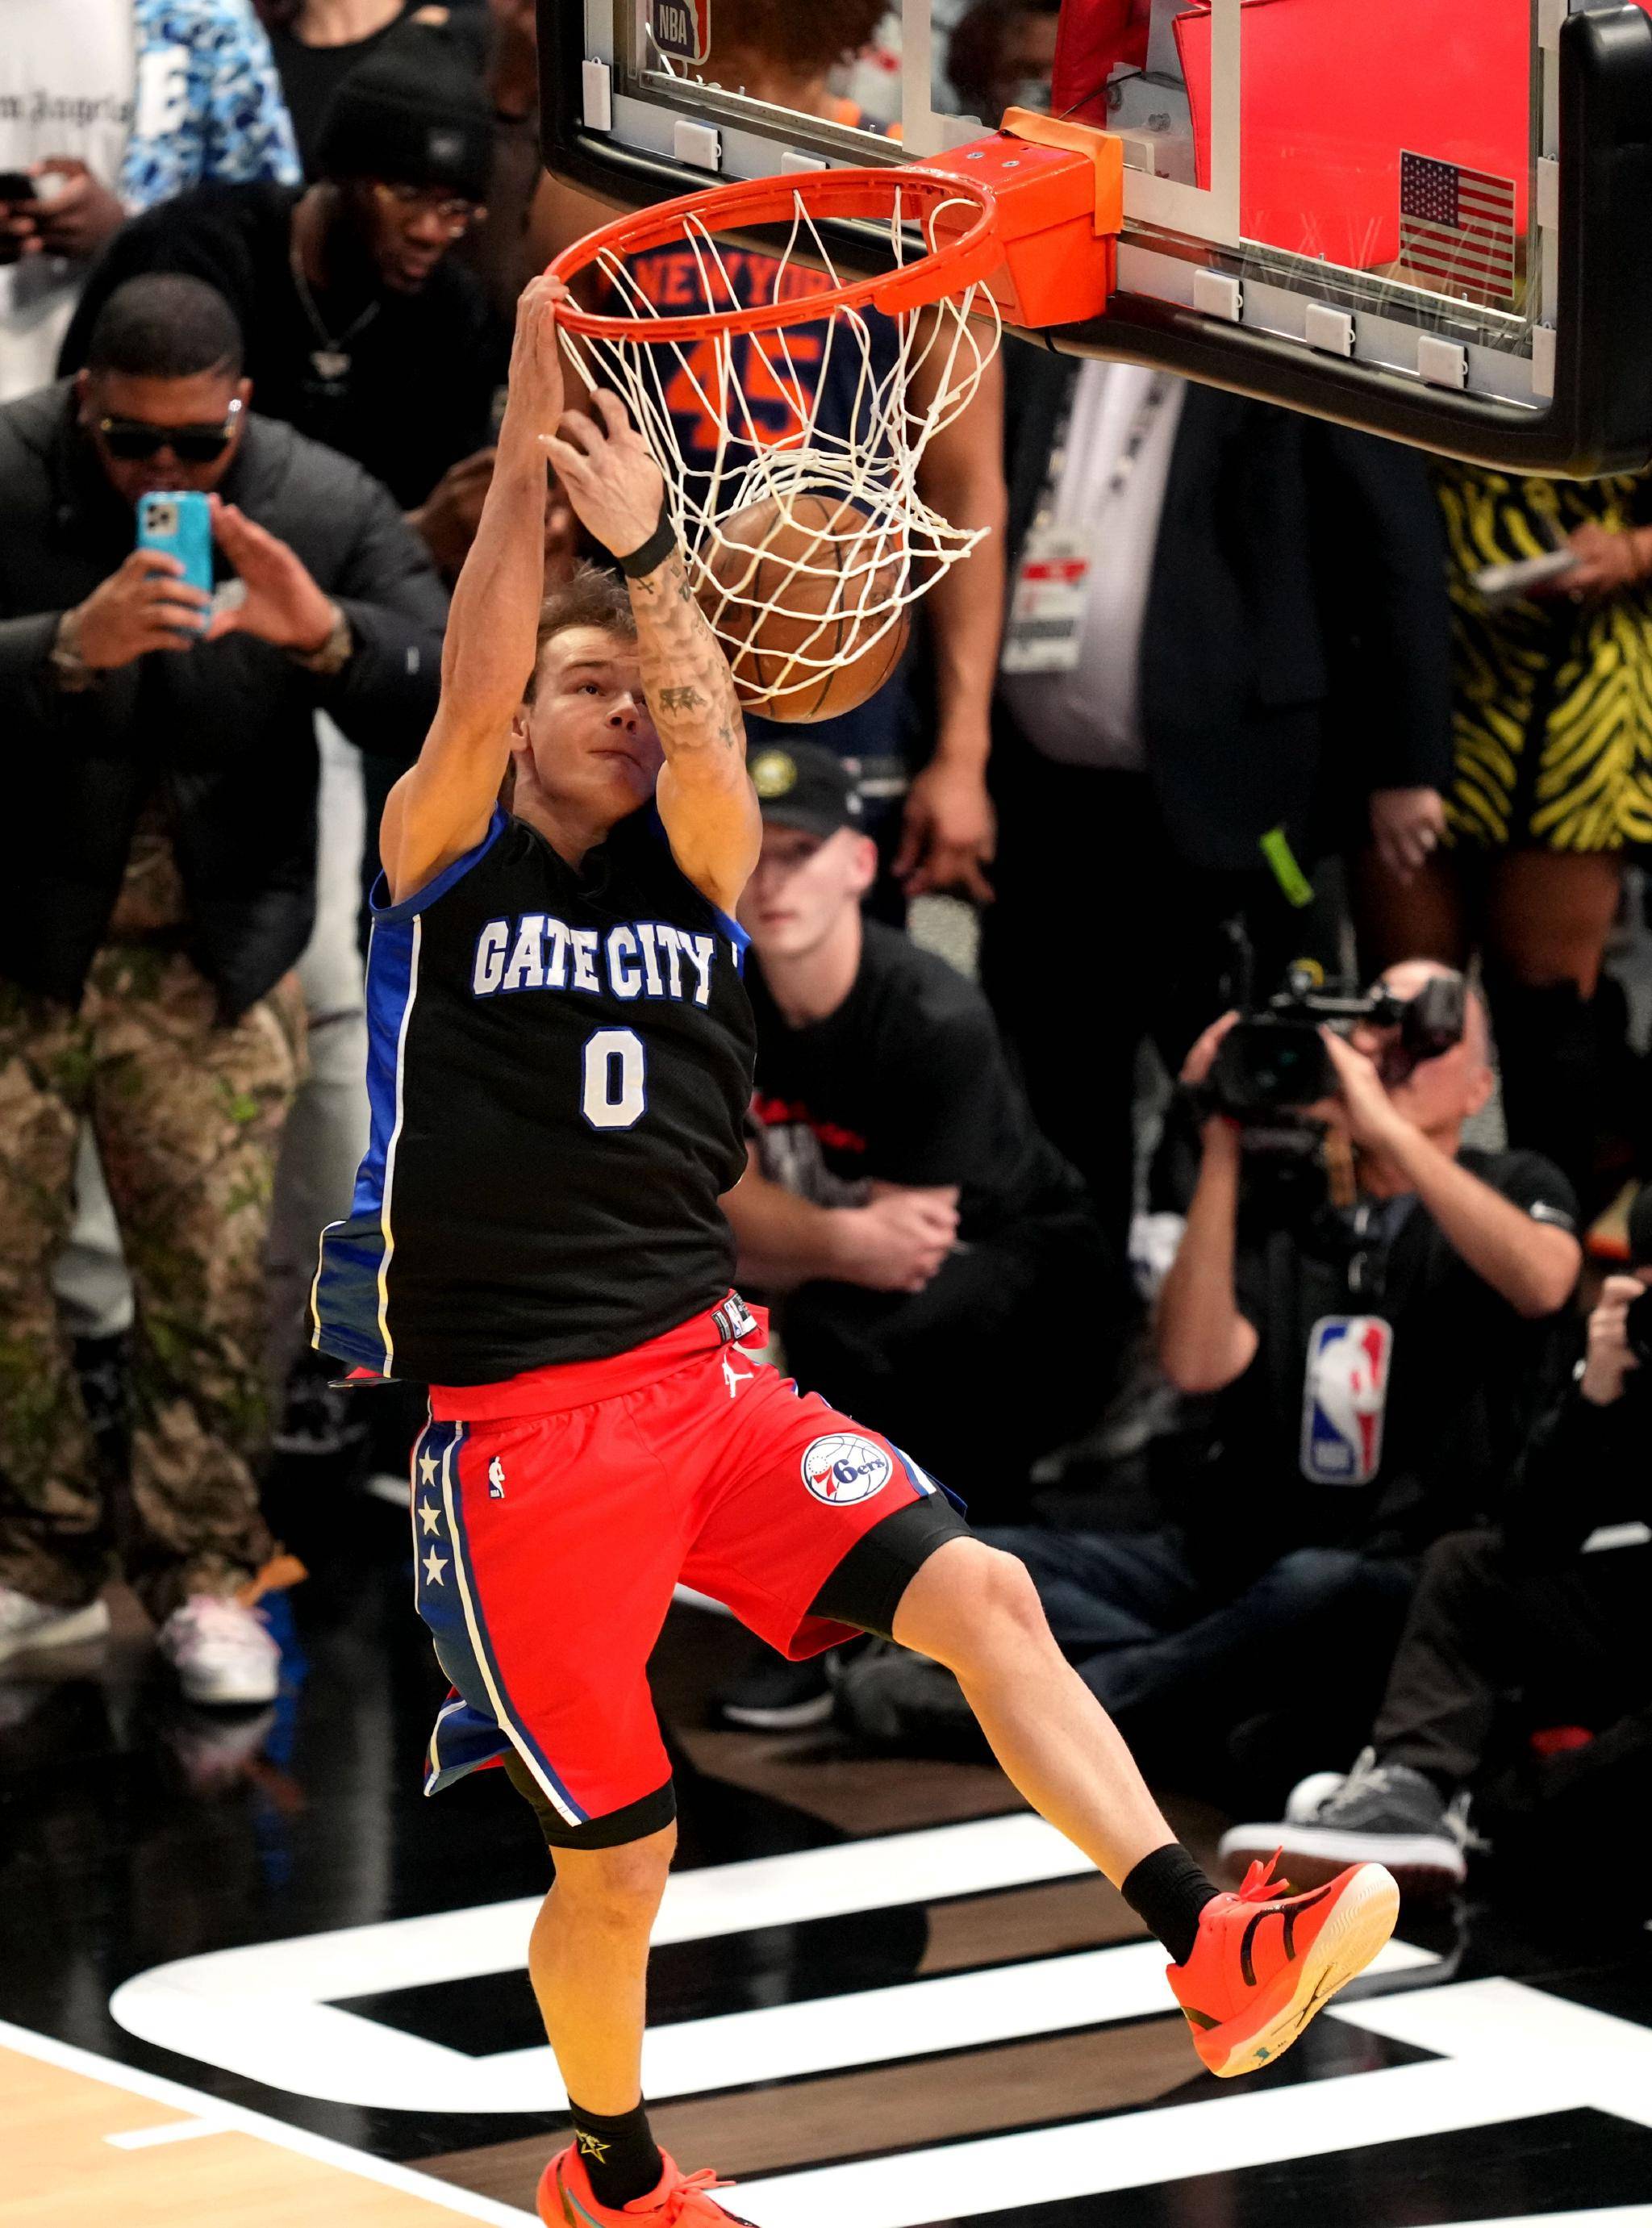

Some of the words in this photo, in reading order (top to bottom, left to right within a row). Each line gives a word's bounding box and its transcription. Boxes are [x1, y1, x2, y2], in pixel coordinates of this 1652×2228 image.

[659, 3, 687, 46] NBA
[632, 252, 742, 310] NEW
[665, 333, 820, 451] 45
[471, 912, 603, 999] GATE
[607, 920, 717, 1009] CITY
[579, 1025, 648, 1131] 0
[812, 1458, 886, 1498] 76ers
